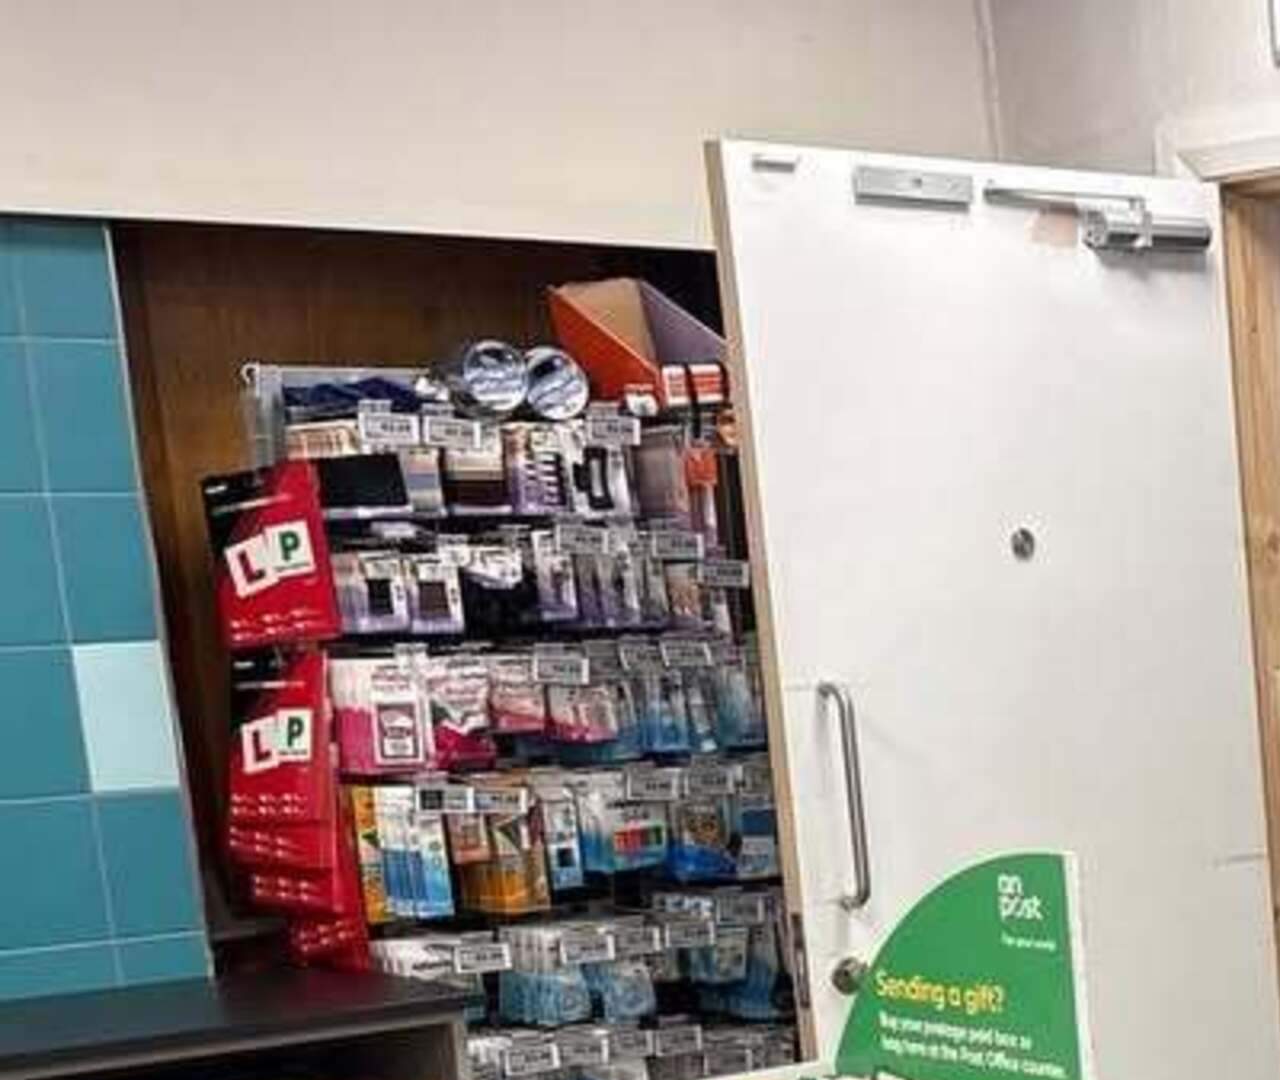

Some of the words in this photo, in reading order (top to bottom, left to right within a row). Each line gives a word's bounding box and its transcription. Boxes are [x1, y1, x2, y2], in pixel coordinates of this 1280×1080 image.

[237, 549, 266, 585] L
[278, 530, 300, 562] P
[252, 729, 271, 763] L
[287, 716, 305, 748] P
[876, 969, 946, 1011] Sending
[948, 985, 962, 1007] a
[964, 981, 1005, 1016] gift?
